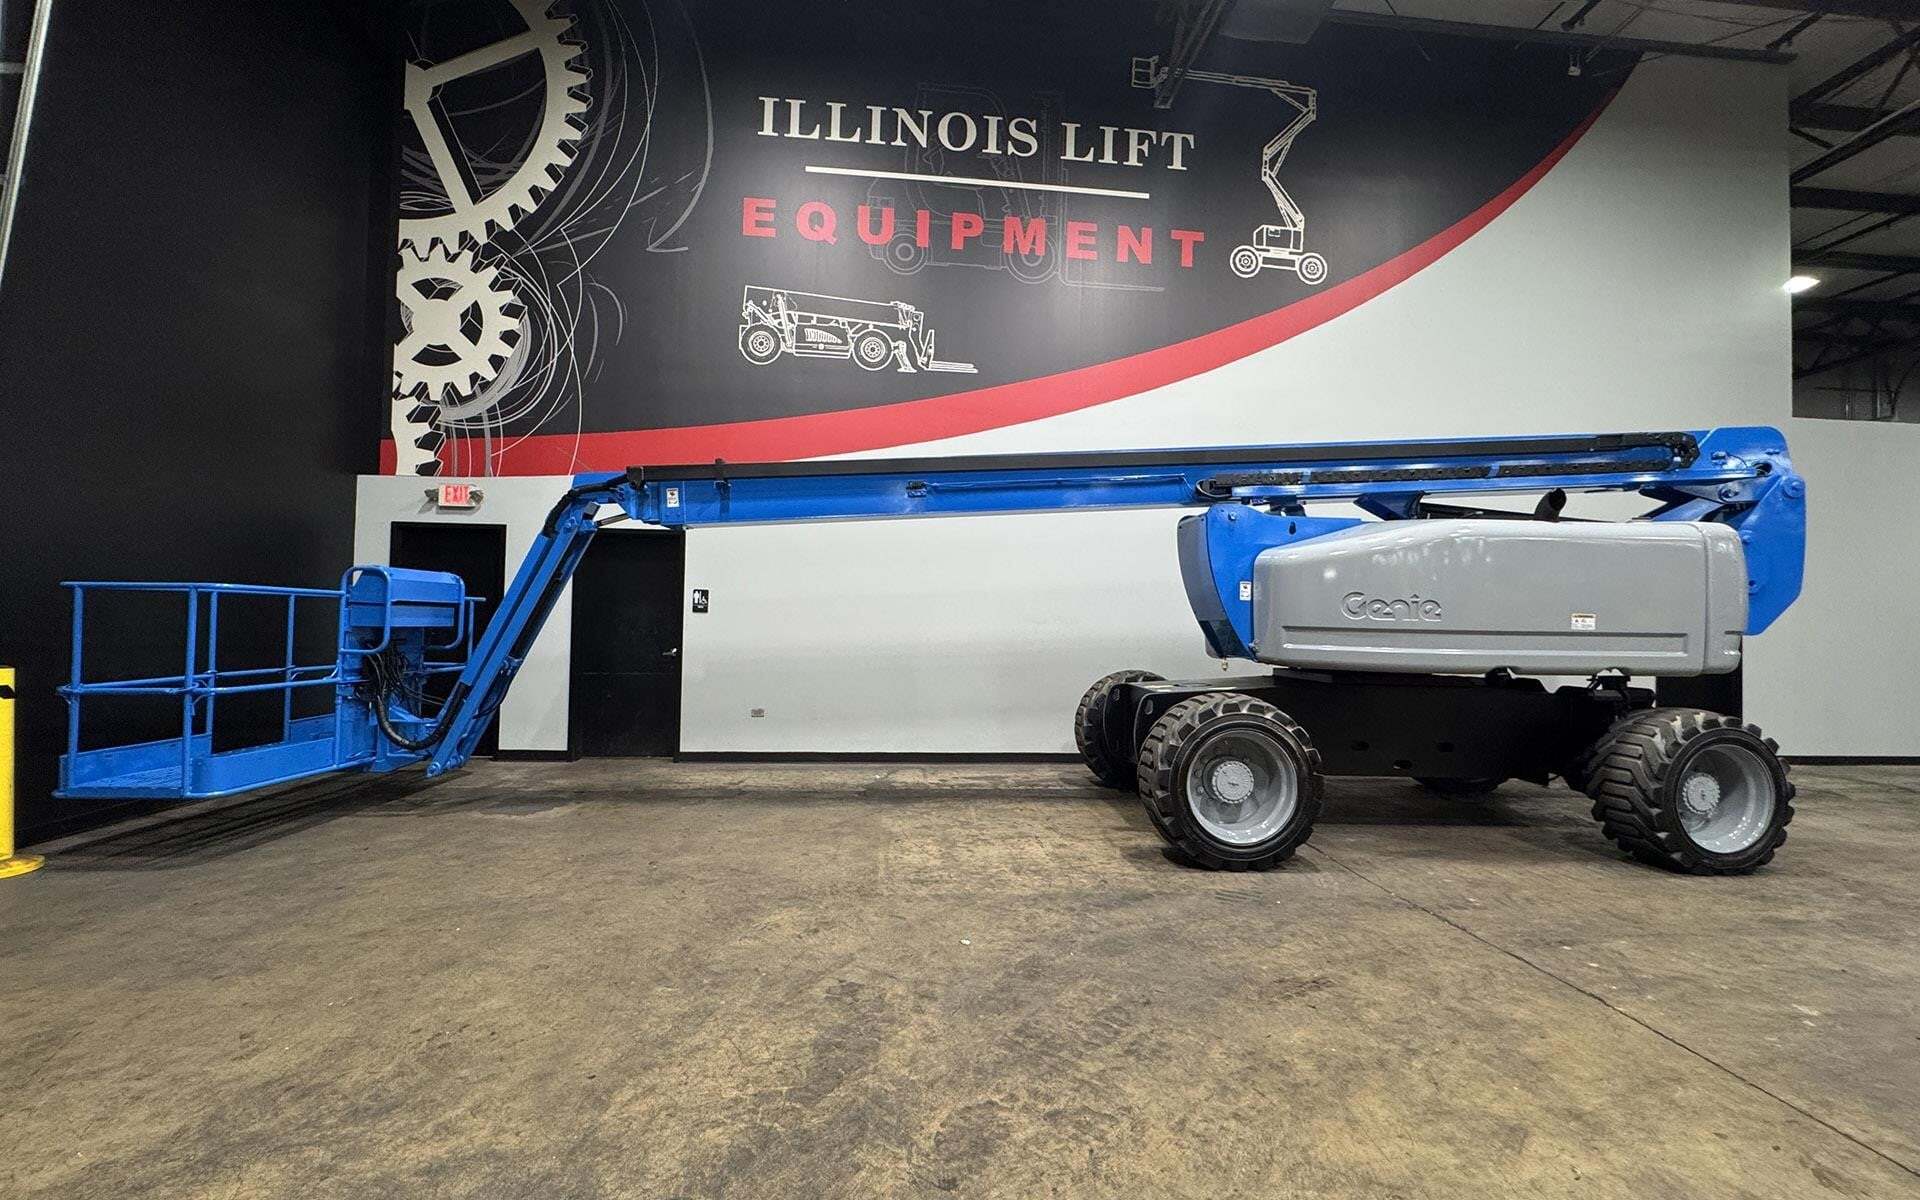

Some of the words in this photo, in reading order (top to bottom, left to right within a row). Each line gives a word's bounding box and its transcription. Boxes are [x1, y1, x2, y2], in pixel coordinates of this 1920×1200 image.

[757, 96, 1038, 157] ILLINOIS
[1060, 122, 1195, 171] LIFT
[742, 197, 1205, 268] EQUIPMENT
[445, 485, 469, 502] EXIT
[1341, 591, 1442, 621] Genie
